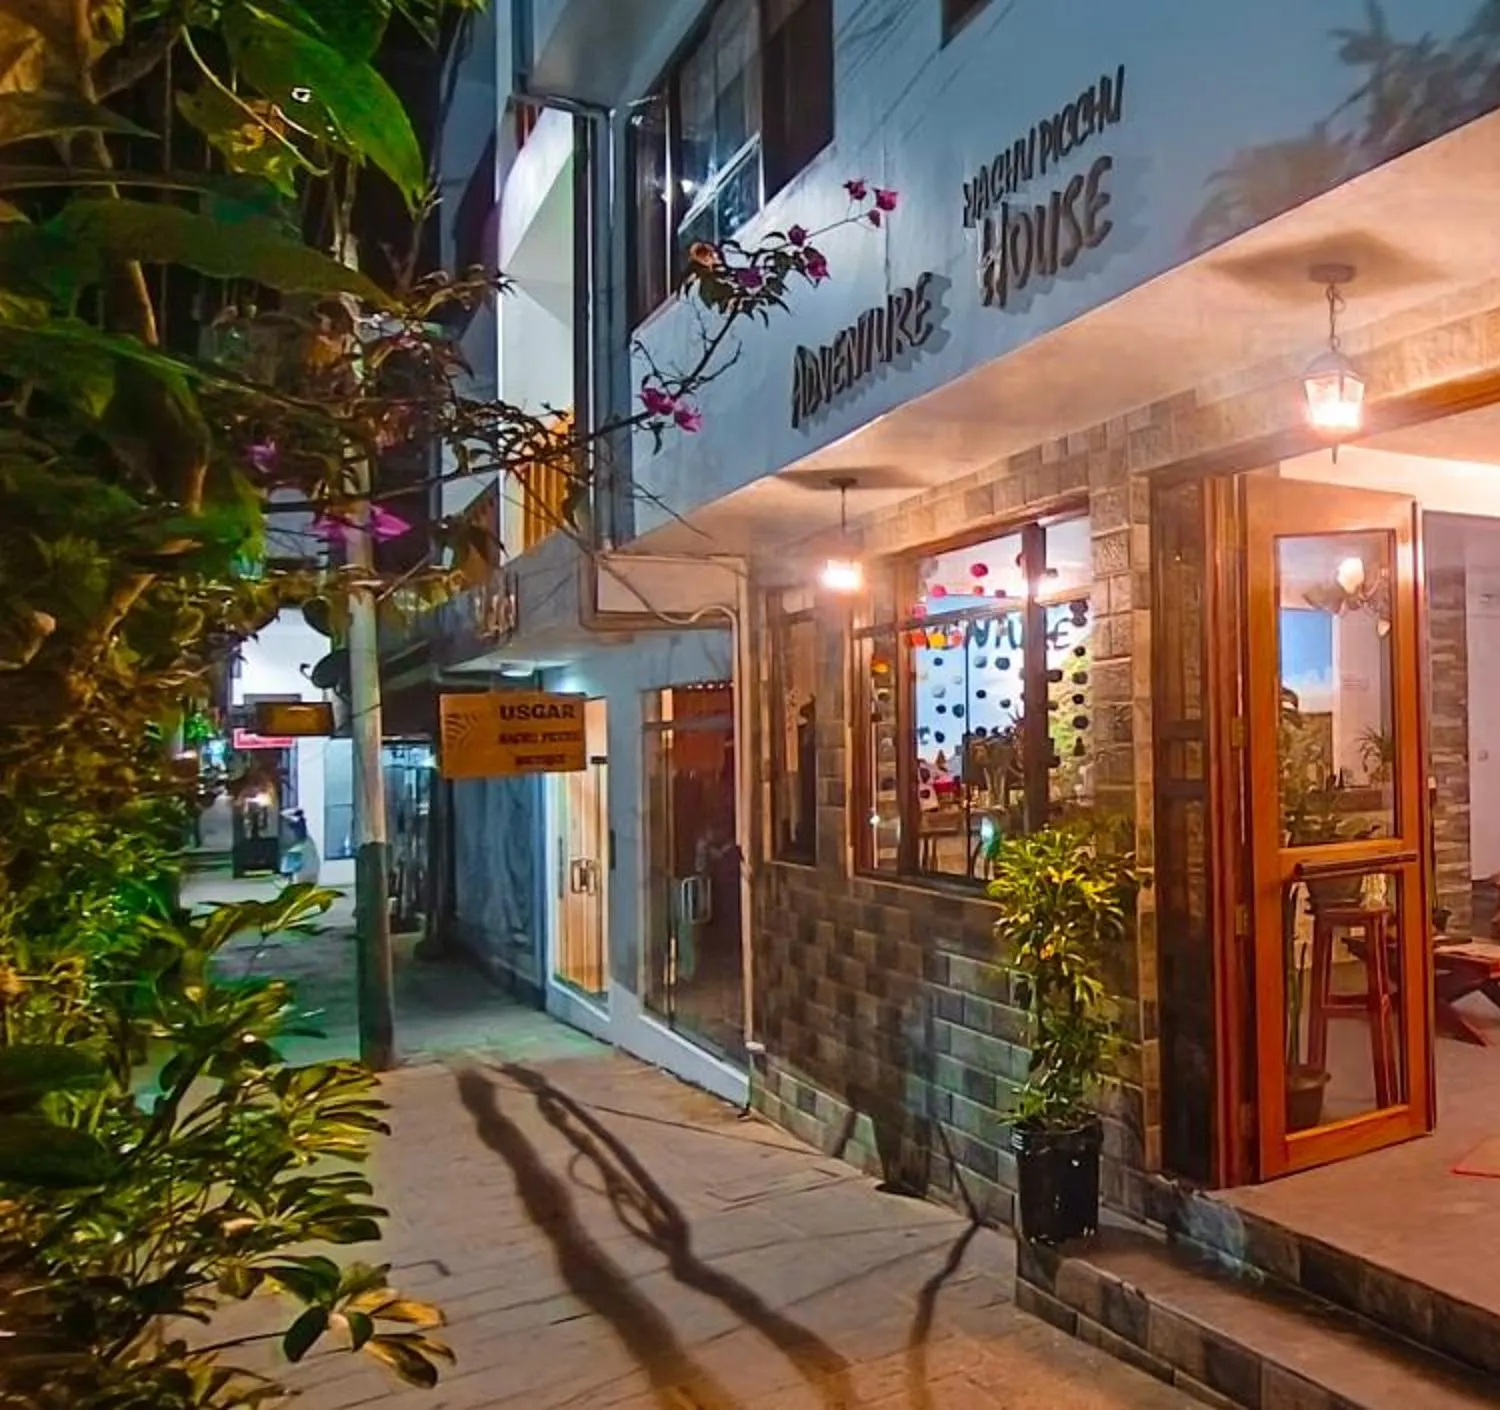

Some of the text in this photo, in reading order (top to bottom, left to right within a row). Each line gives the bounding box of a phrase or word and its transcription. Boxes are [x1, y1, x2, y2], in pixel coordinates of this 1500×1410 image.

[962, 63, 1126, 228] MACHU PICCHU
[791, 154, 1114, 429] ADVENTURE HOUSE
[499, 703, 577, 721] USGAR
